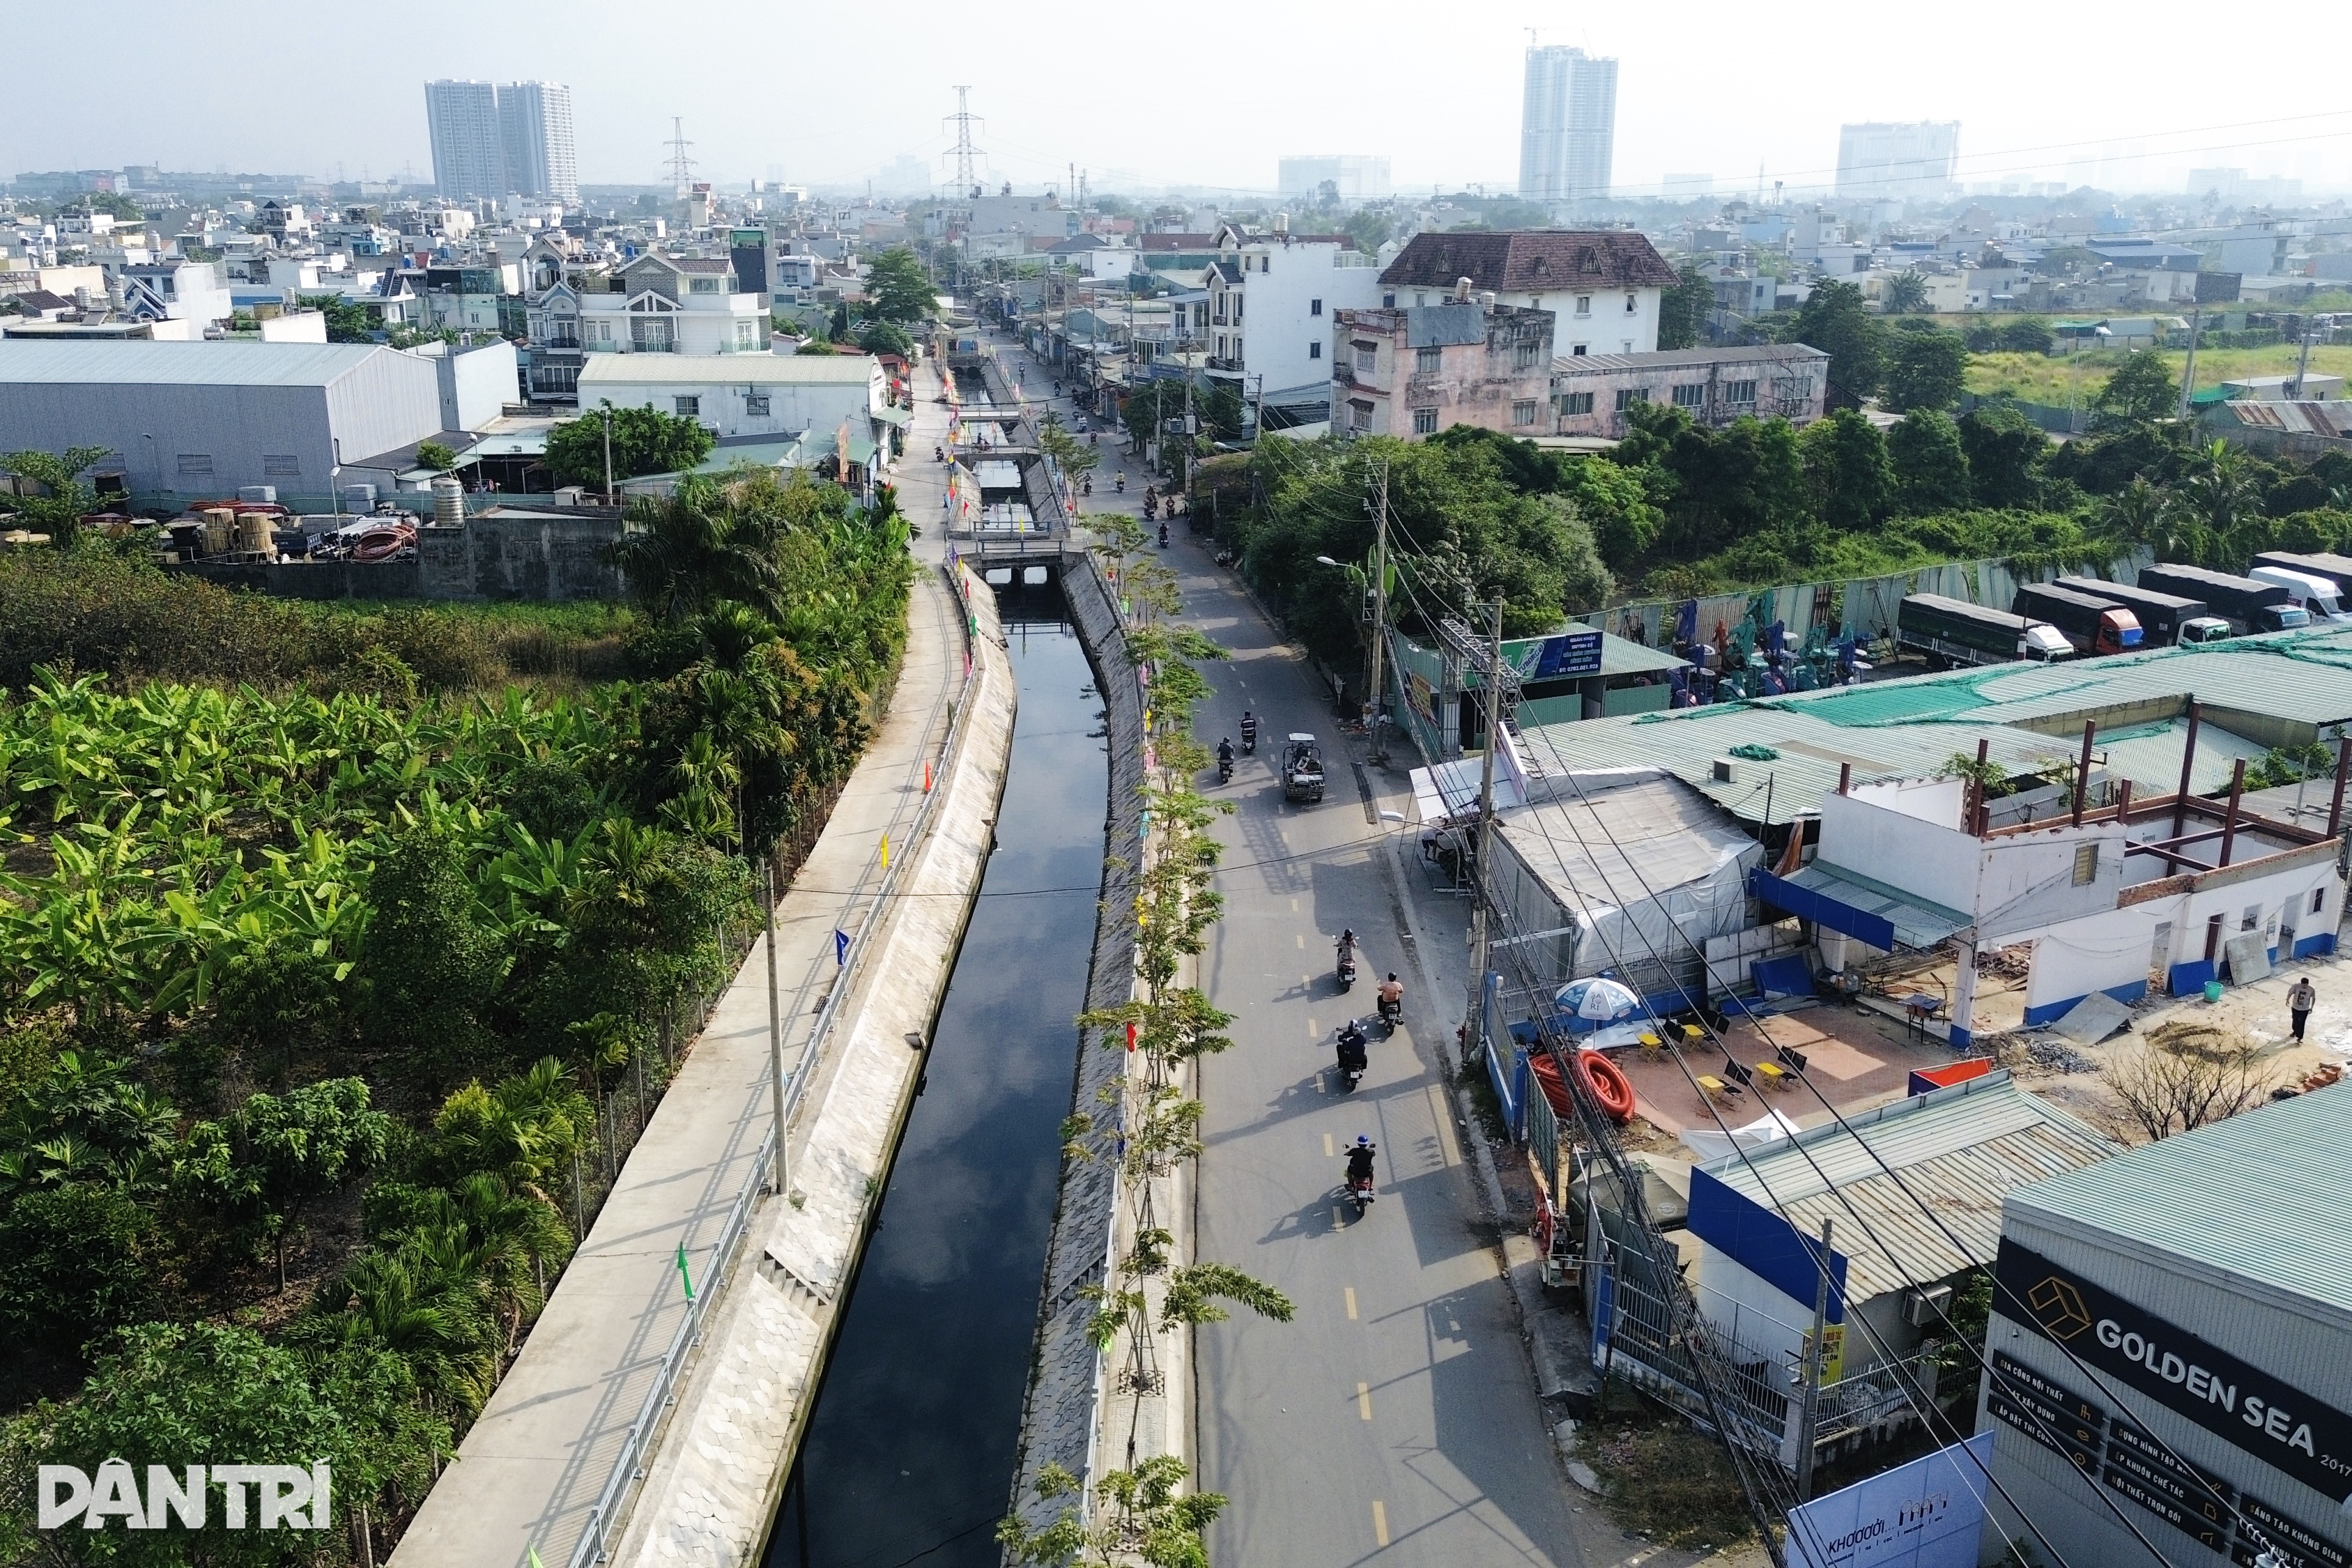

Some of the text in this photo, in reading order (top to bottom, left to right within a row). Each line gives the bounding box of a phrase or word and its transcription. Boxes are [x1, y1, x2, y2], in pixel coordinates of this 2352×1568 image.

[2013, 1367, 2031, 1383] CÔNG
[2032, 1377, 2044, 1390] NỘI
[2045, 1385, 2063, 1402] THẤT
[2022, 1396, 2036, 1410] XÂY
[2096, 1319, 2352, 1477] GOLDEN SEA 2017
[2009, 1412, 2022, 1426] ĐẶT
[2024, 1420, 2036, 1434] THI
[2139, 1439, 2158, 1457] HÌNH
[2160, 1452, 2174, 1467] TẠO
[2126, 1459, 2151, 1479] KHUÔN
[2153, 1474, 2169, 1489] CHẾ
[2169, 1484, 2184, 1498] TÁC
[2111, 1475, 2182, 1524] NỘI THẤT TRỌN GÓI
[2250, 1504, 2343, 1565] SÁNG TẠO KHÔNG GIAN
